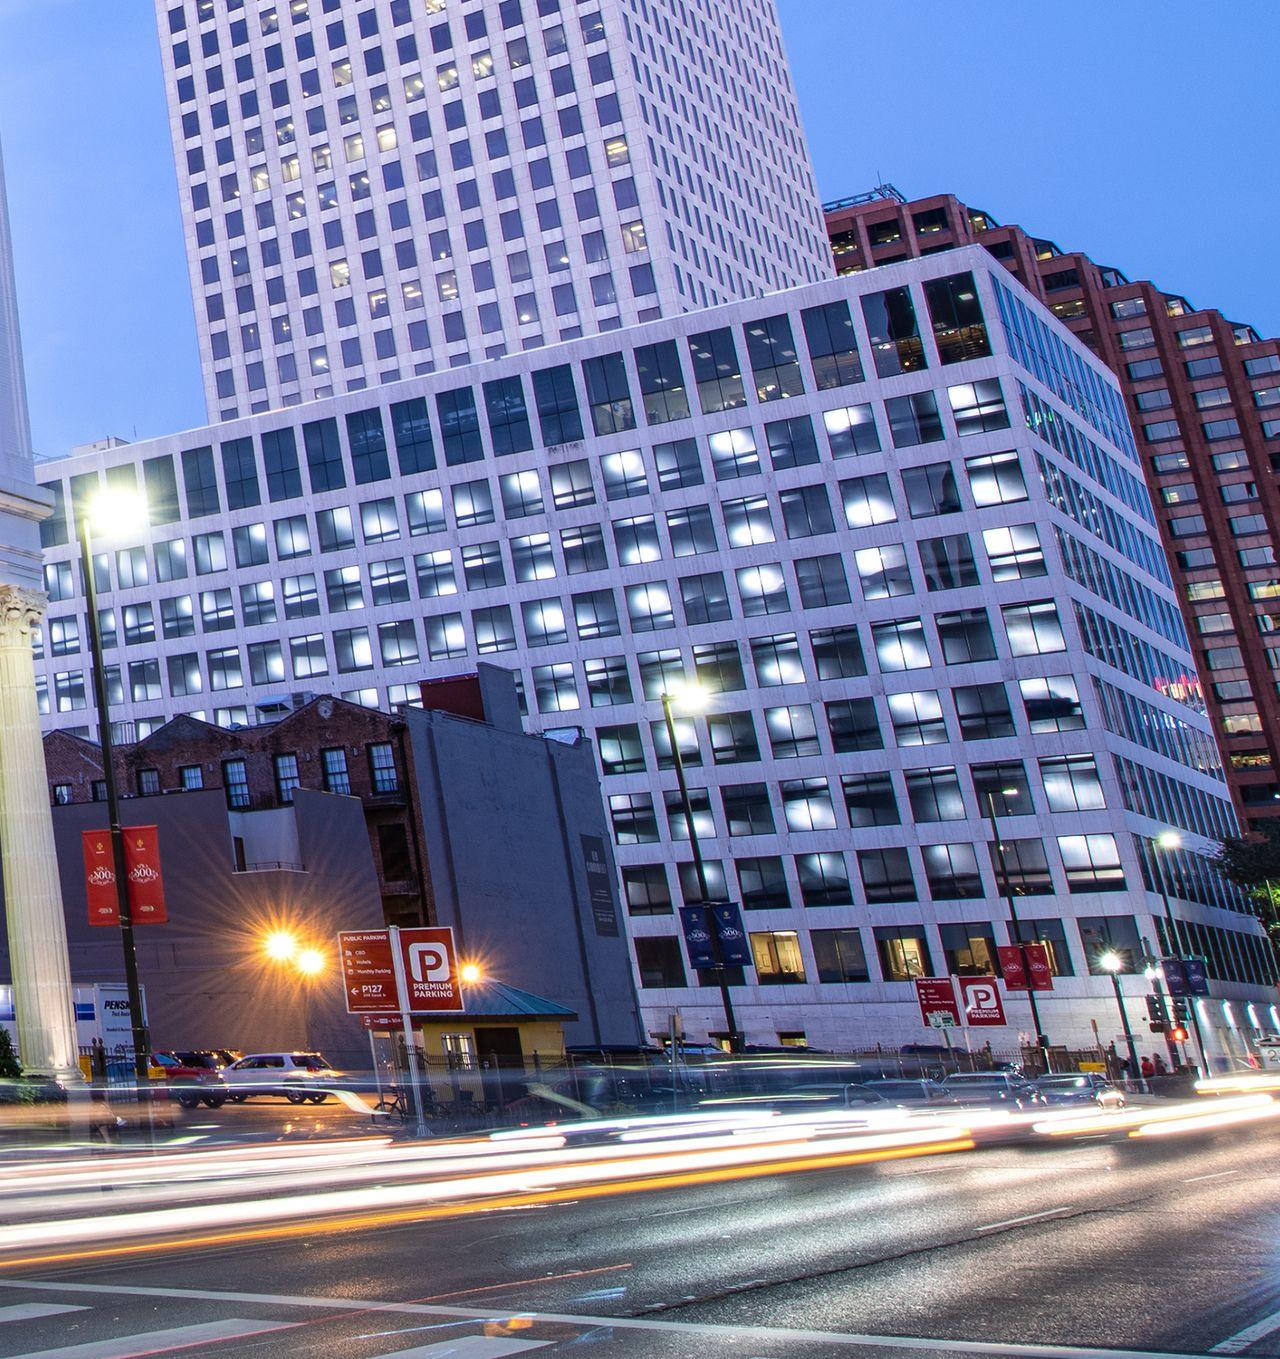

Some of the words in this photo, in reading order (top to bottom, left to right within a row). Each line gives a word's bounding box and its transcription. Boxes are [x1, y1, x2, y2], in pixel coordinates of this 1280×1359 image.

[362, 985, 383, 993] P127
[413, 983, 452, 991] PREMIUM
[414, 990, 454, 998] PARKING
